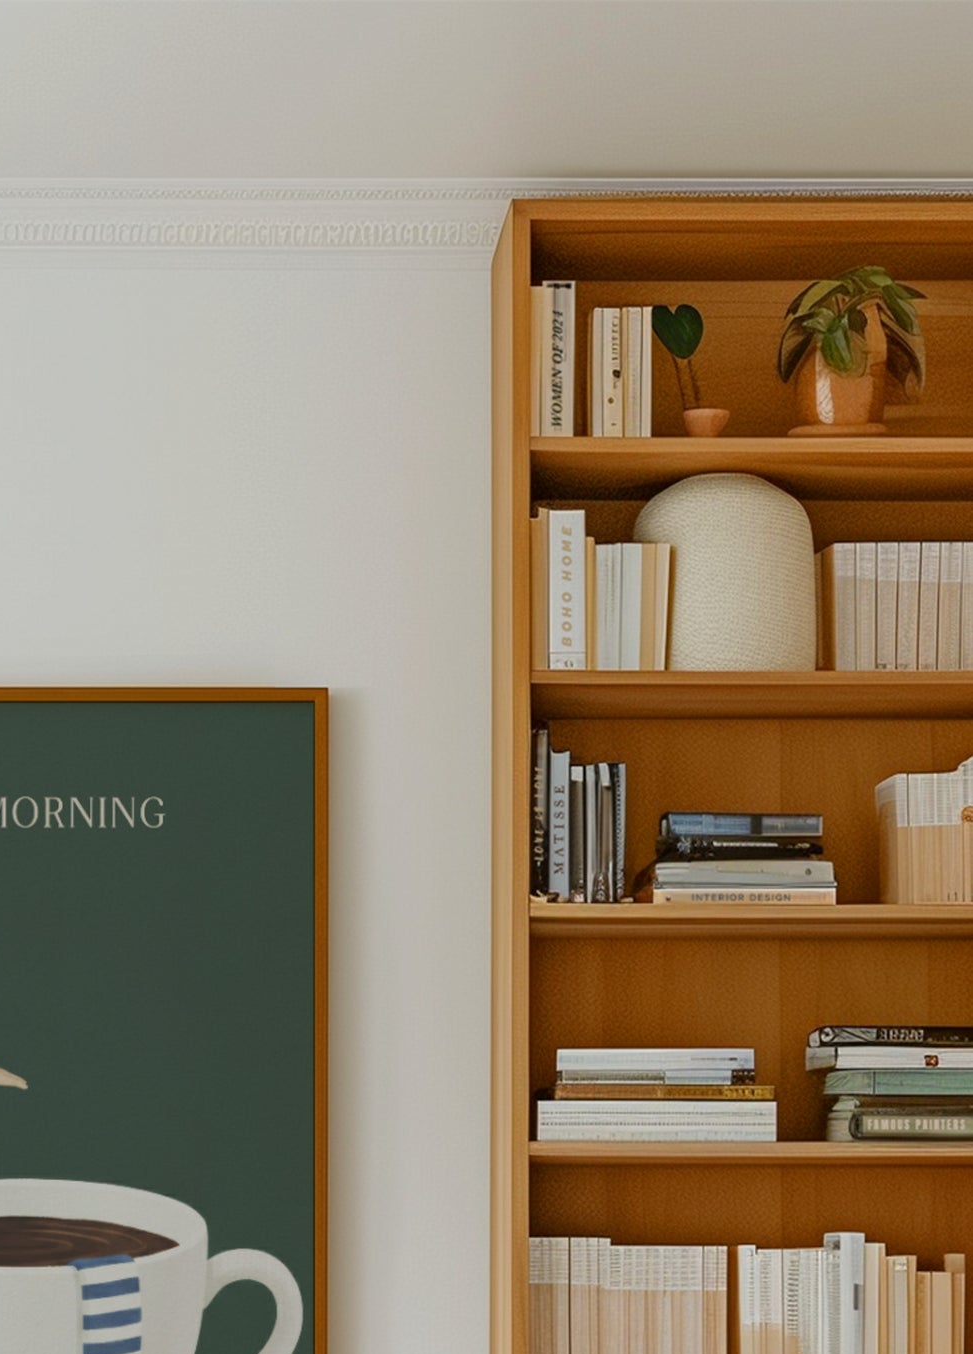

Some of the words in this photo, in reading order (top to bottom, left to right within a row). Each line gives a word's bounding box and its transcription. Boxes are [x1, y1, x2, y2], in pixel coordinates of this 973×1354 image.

[551, 309, 564, 341] 2024
[550, 341, 564, 365] OF
[550, 367, 564, 428] WOMEN
[561, 525, 573, 581] HOME
[561, 591, 573, 647] BOHO
[553, 784, 565, 874] MATISSE
[691, 893, 745, 902] INTERIOR
[749, 893, 791, 902] DESIGN
[866, 1118, 911, 1131] FAMOUS
[914, 1118, 966, 1131] PAINTERS
